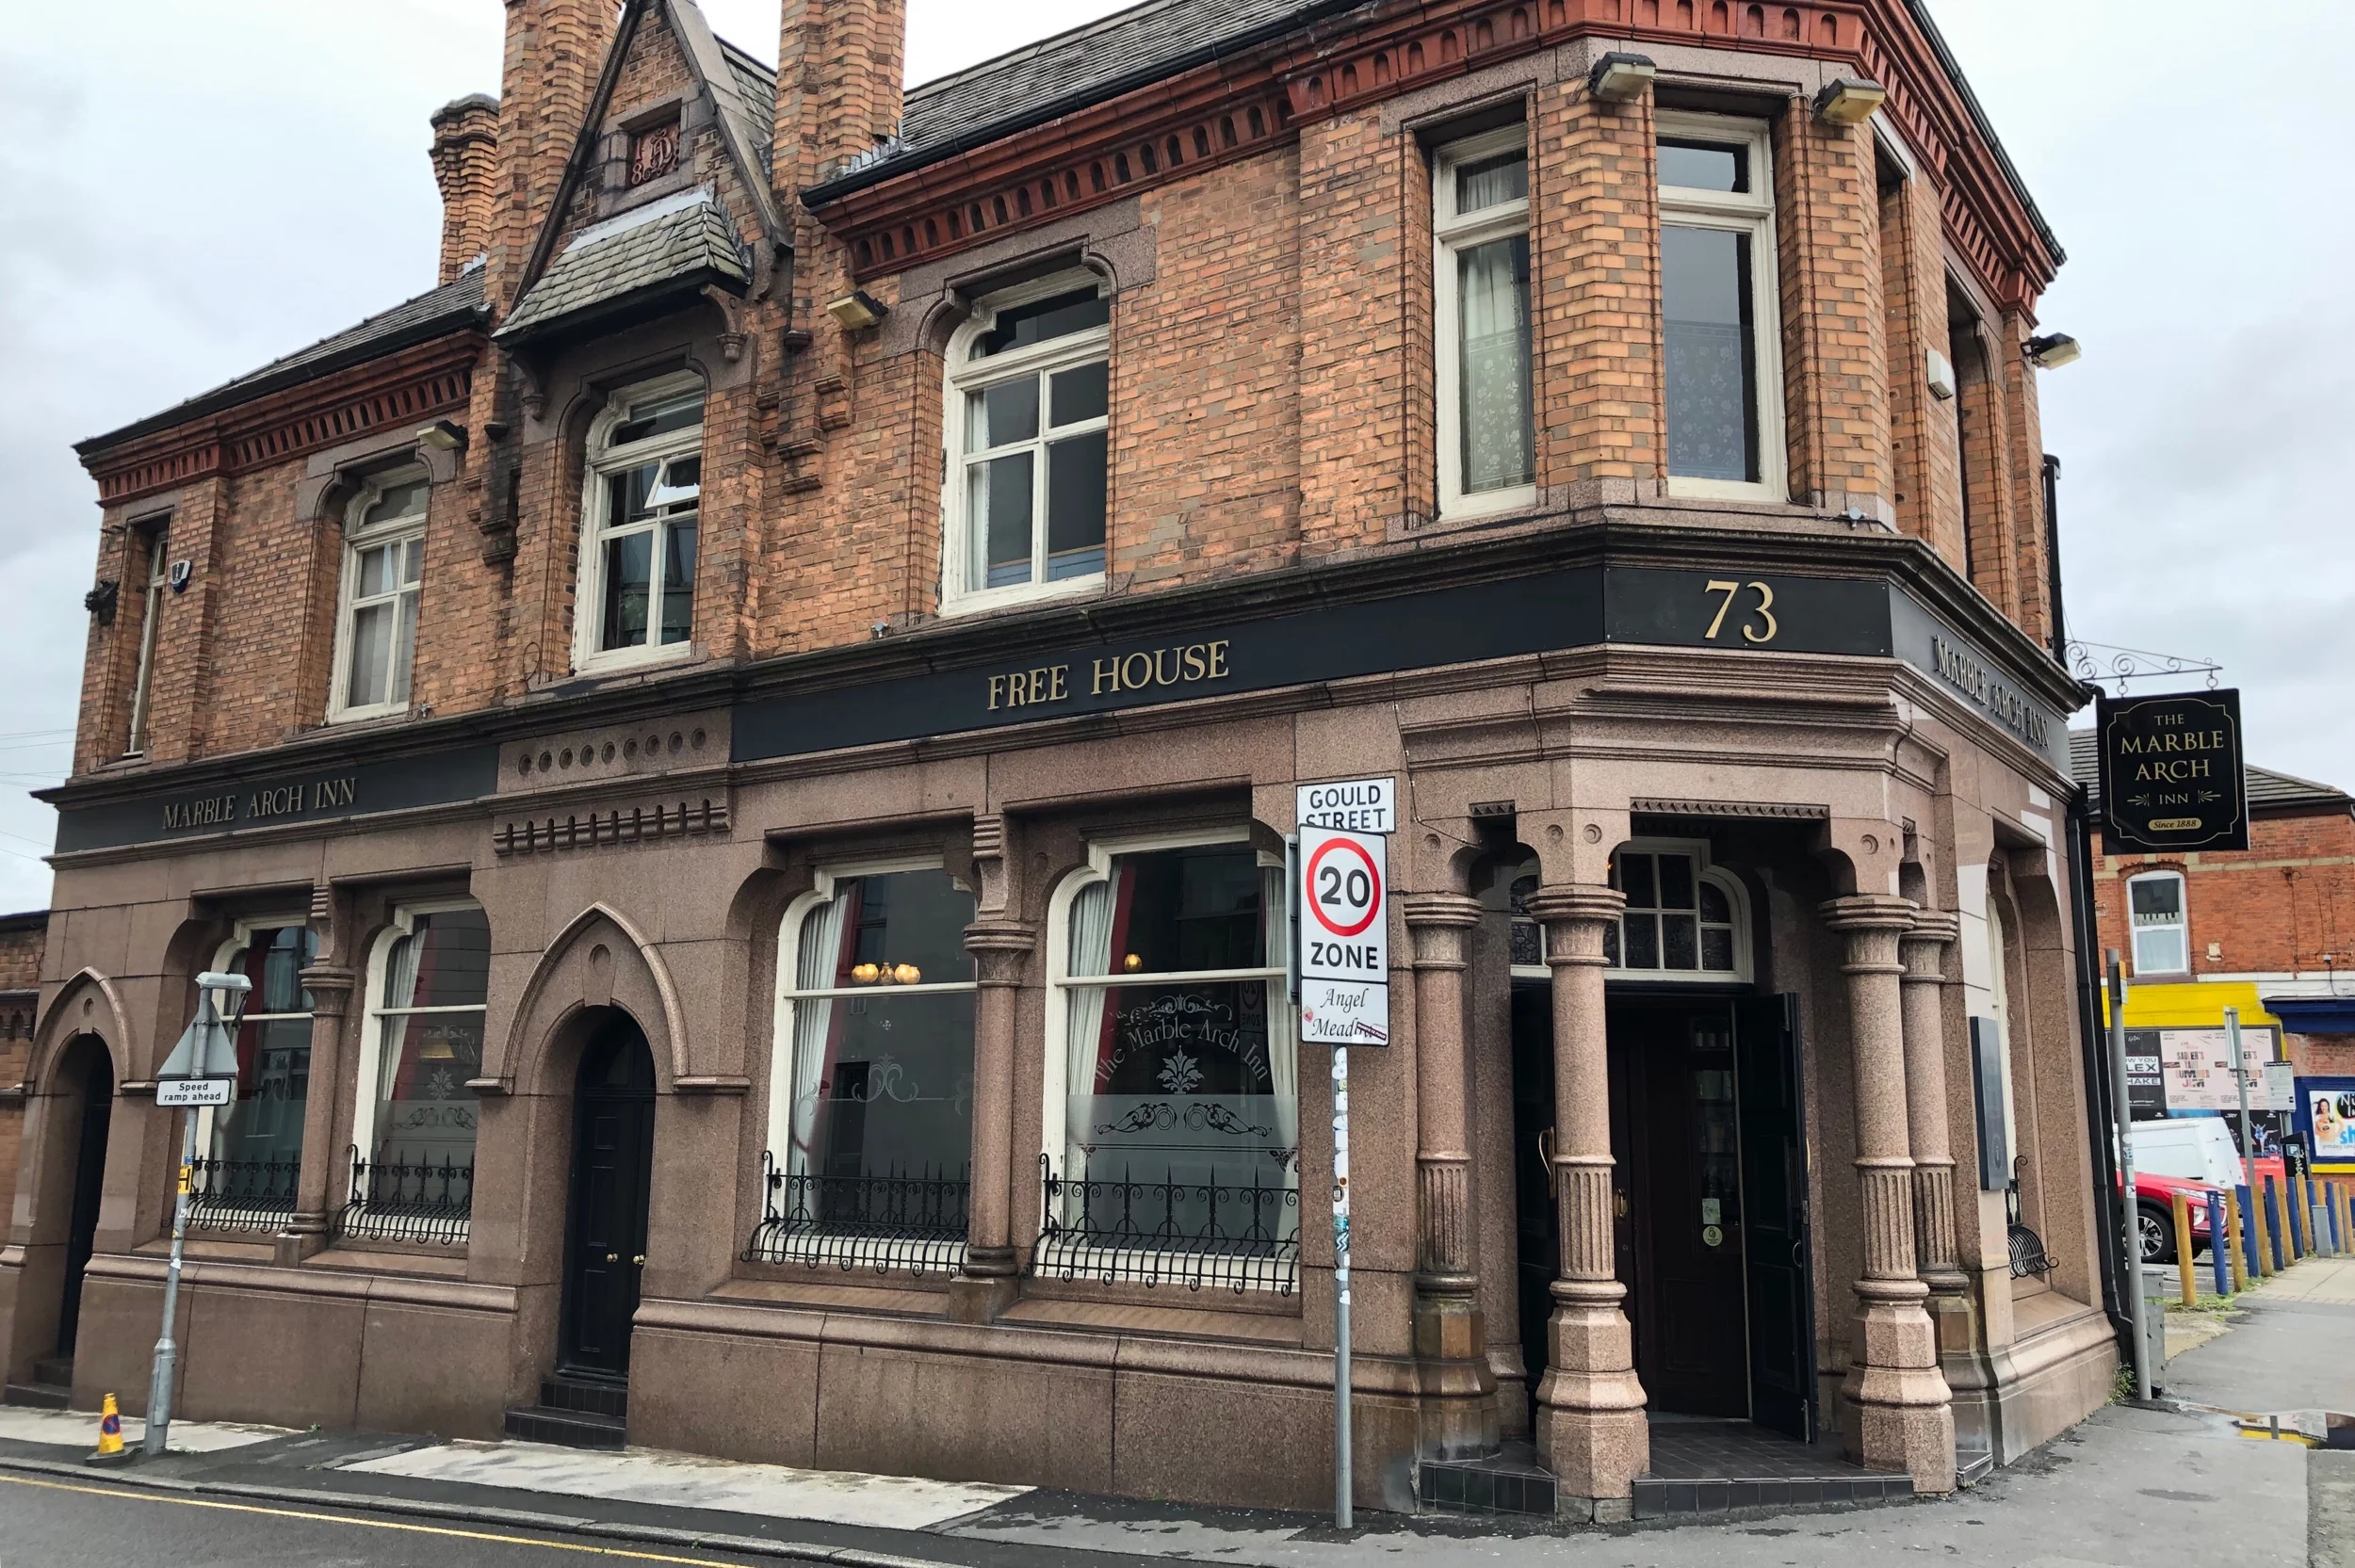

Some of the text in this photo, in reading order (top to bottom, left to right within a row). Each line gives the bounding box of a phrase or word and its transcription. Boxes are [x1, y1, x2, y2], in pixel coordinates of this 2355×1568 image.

[1705, 579, 1778, 642] 73
[987, 639, 1229, 710] FREE HOUSE
[1935, 634, 2050, 751] MARBLE ARCH INN
[2154, 714, 2184, 726] THE
[2120, 730, 2224, 754] MARBLE
[2135, 759, 2210, 784] ARCH
[162, 777, 356, 830] MARBLE ARCH INN
[1309, 784, 1381, 809] GOULD
[2159, 793, 2188, 805] INN
[1306, 808, 1386, 830] STREET
[2153, 819, 2197, 829] Since 1888
[1320, 866, 1370, 908] 20
[1311, 942, 1378, 970] ZONE
[1320, 988, 1369, 1013] Angel
[1094, 1016, 1270, 1082] The Marble Arch Inn
[179, 1083, 208, 1092] Speed
